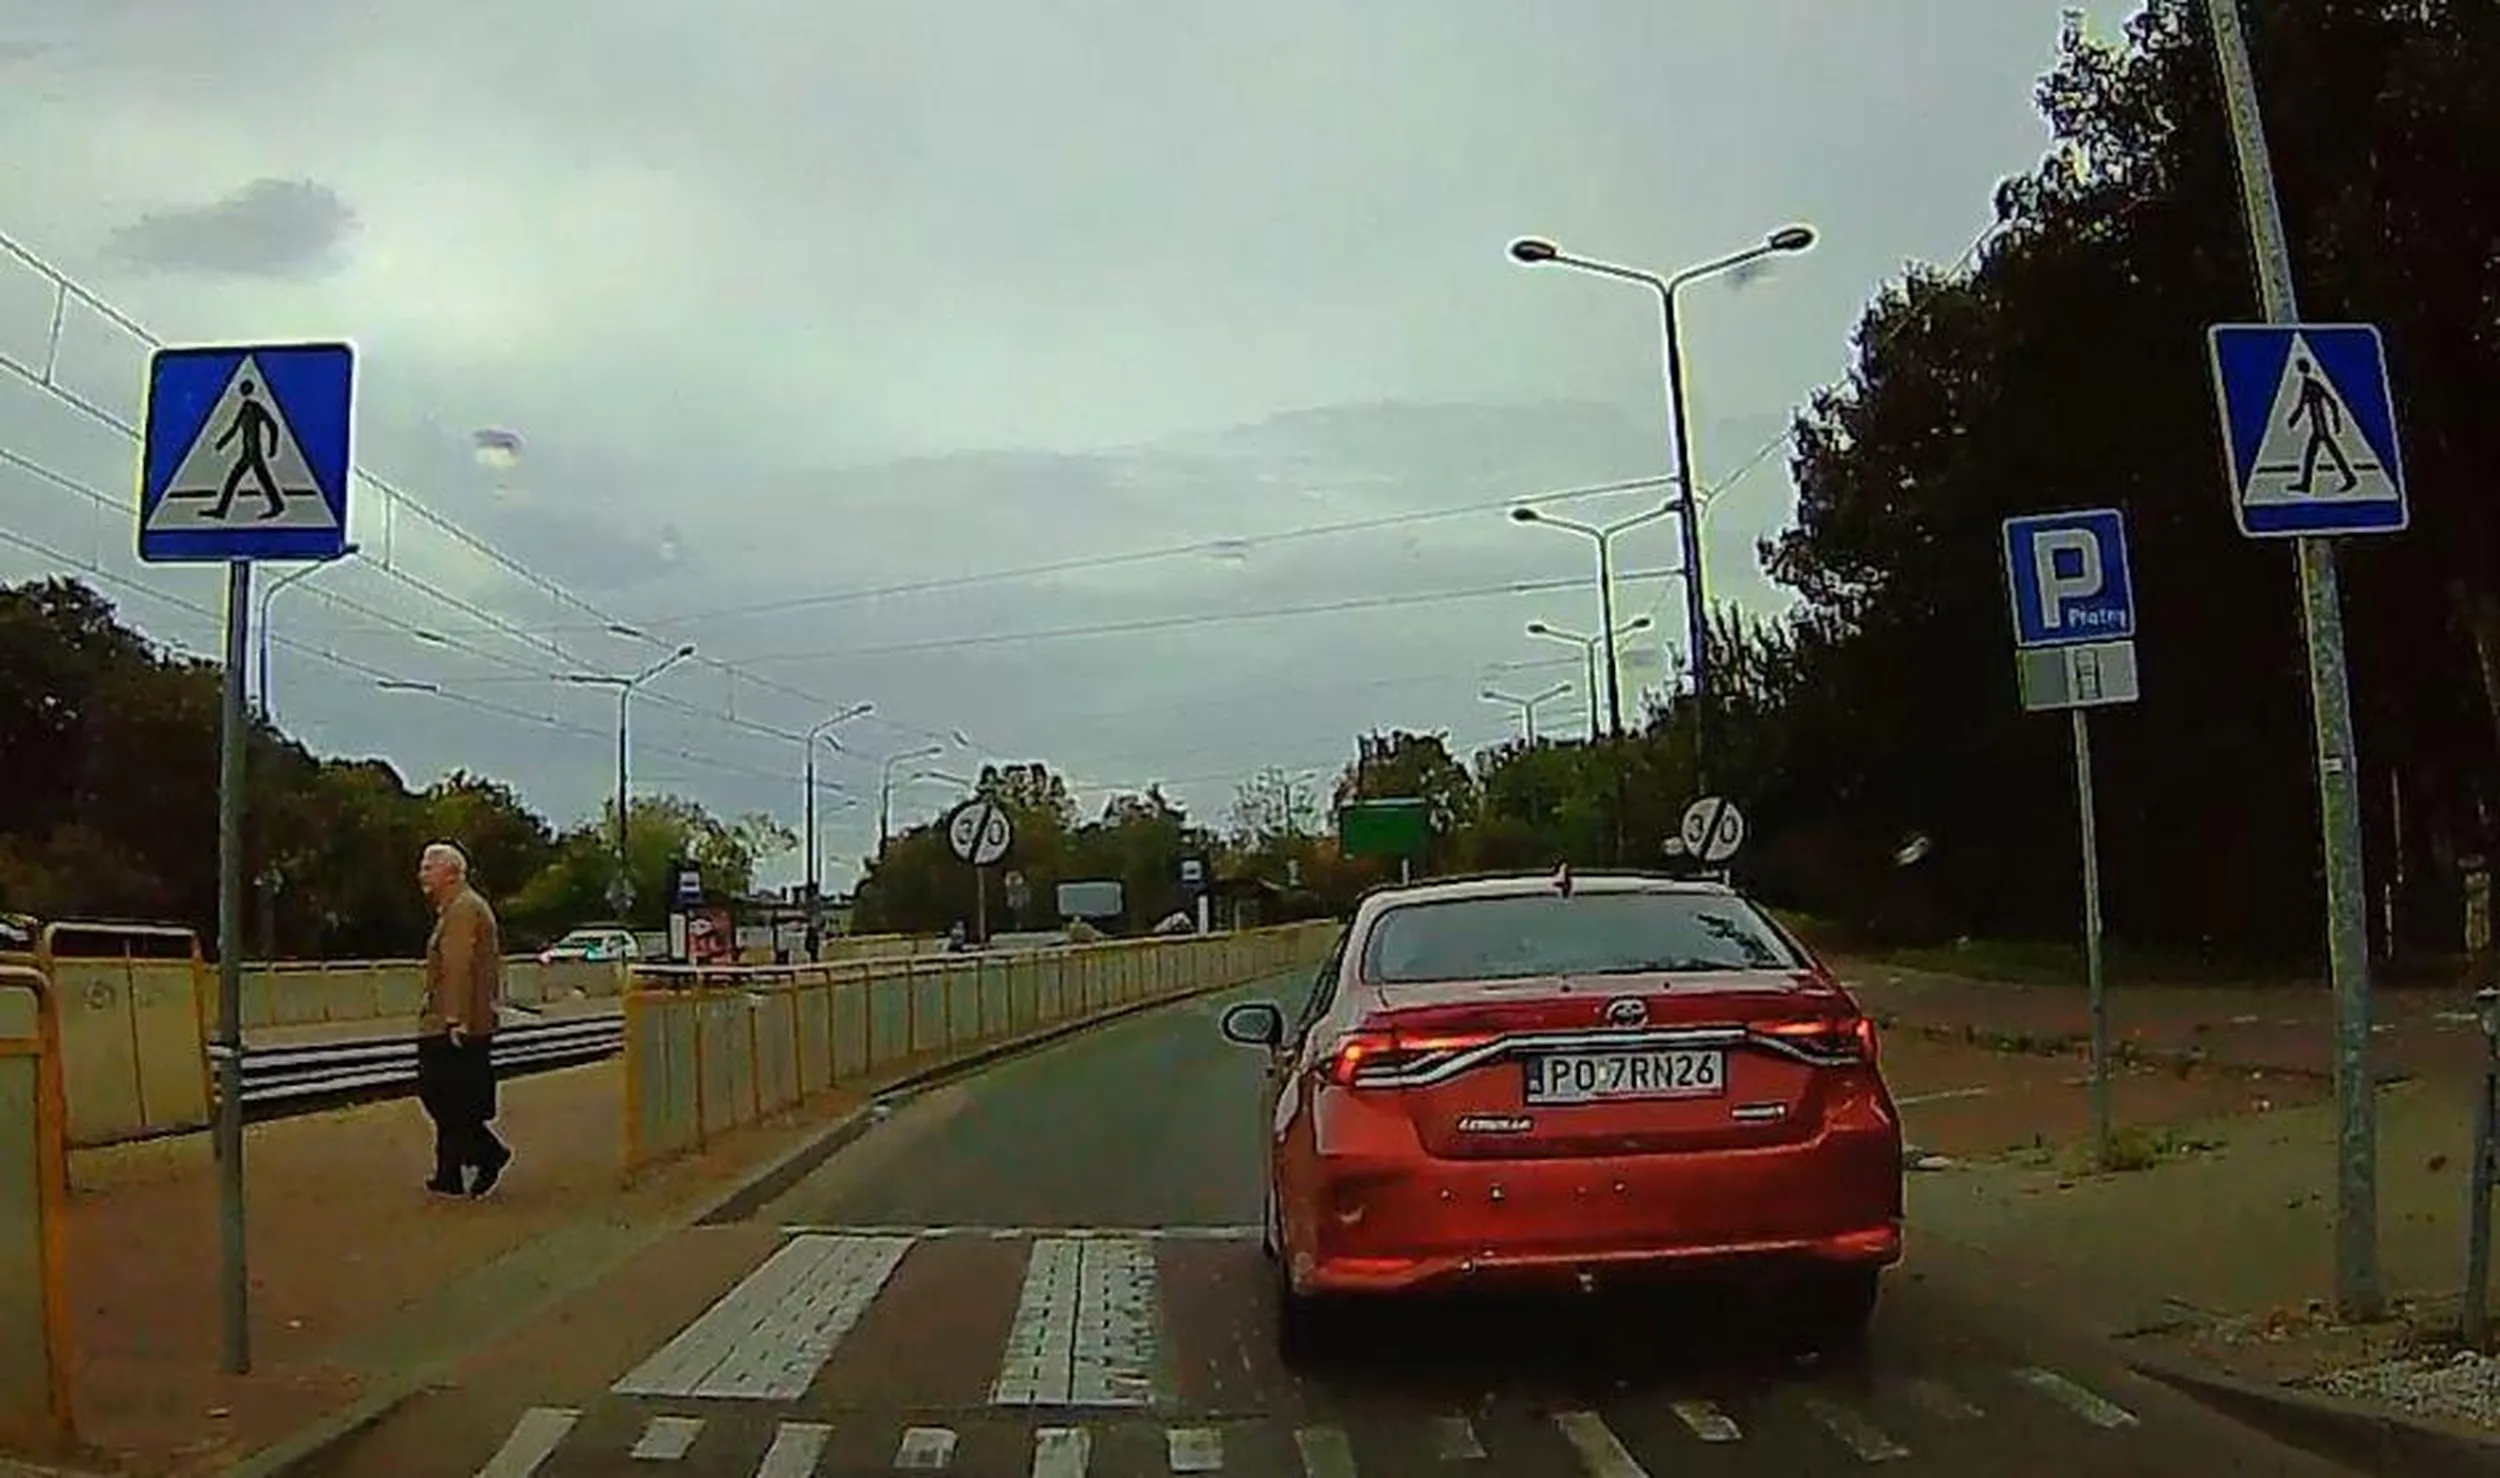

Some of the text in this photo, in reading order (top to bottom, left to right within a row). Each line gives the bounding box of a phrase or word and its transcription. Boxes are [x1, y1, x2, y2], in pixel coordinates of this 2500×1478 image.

[2033, 529, 2102, 629] P
[956, 818, 1005, 846] 30
[1687, 813, 1738, 844] 30
